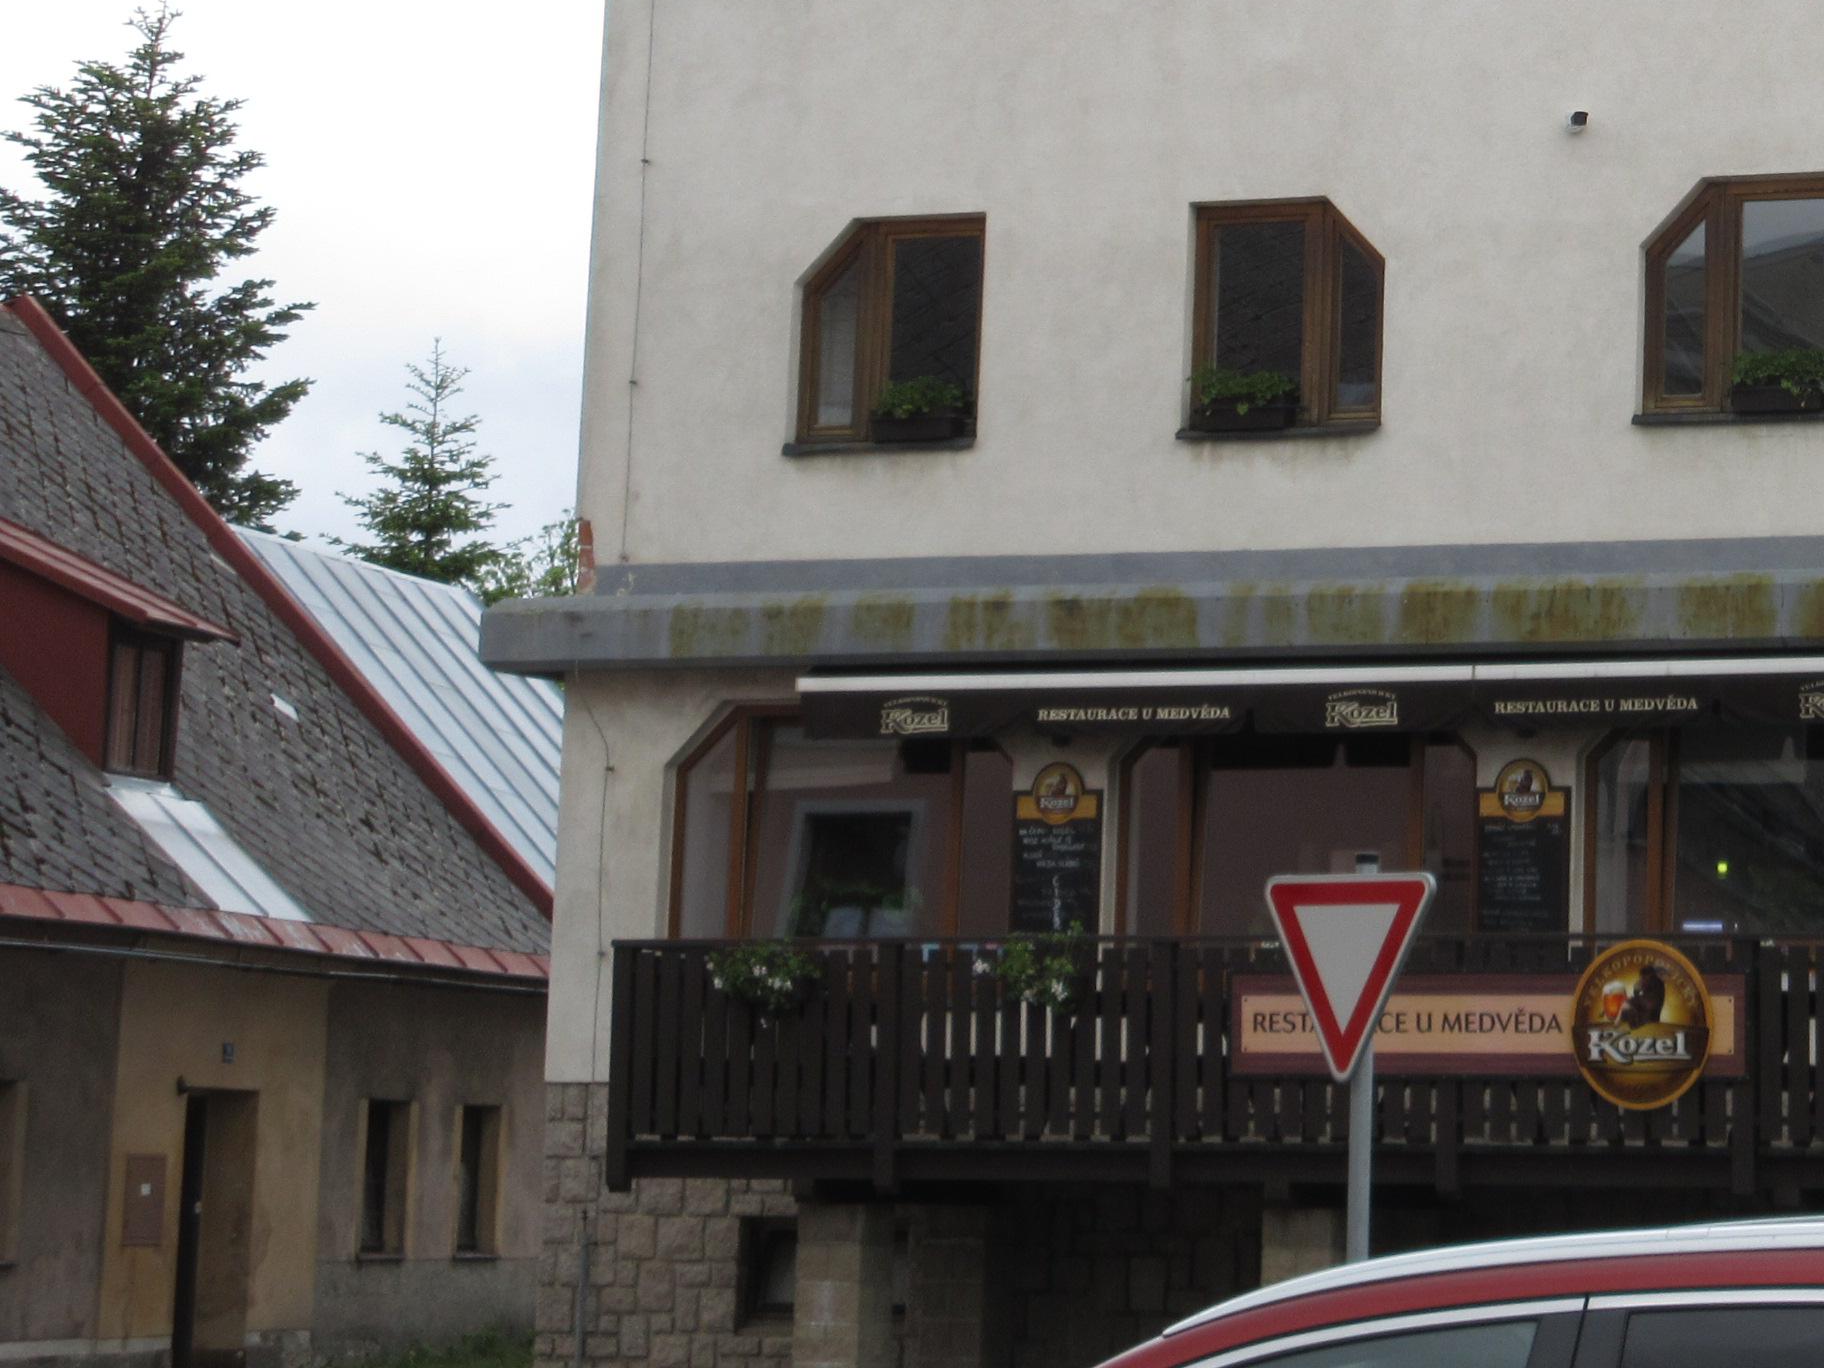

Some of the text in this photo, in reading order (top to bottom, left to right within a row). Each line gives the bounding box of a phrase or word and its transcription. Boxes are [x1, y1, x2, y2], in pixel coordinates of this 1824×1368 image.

[1037, 707, 1138, 721] RESTAURACE
[1142, 707, 1153, 720] U
[1325, 700, 1399, 728] Kozel
[1494, 699, 1600, 714] RESTAURACE
[1604, 699, 1615, 712] U
[880, 707, 950, 735] Kozel
[1252, 1007, 1563, 1034] RESTCE U MEDVĚDA
[1586, 1028, 1692, 1065] Kozel
